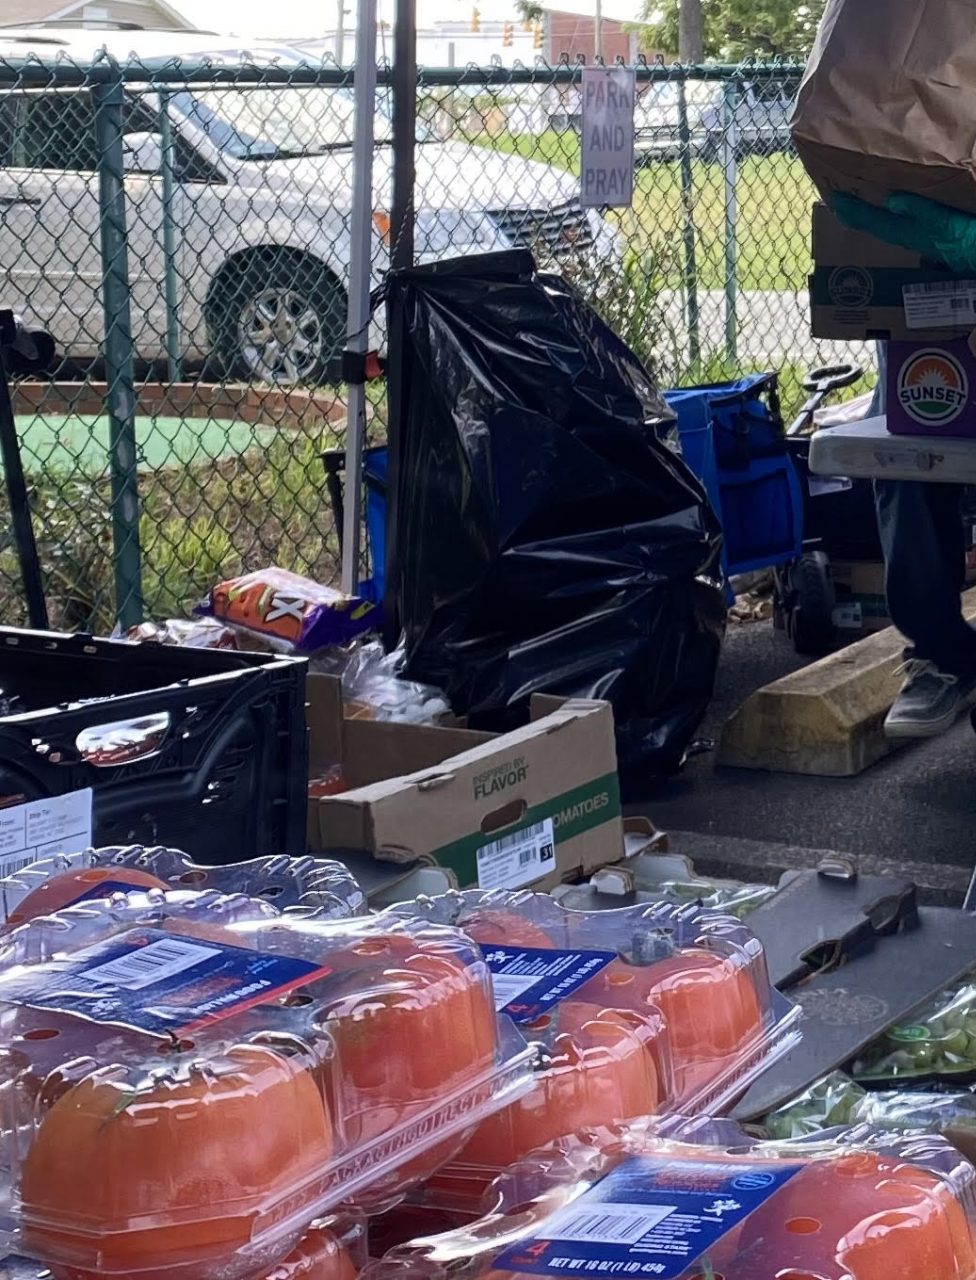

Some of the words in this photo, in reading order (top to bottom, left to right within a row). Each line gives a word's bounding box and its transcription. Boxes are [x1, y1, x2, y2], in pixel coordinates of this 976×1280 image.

[585, 81, 630, 108] PARK
[590, 124, 625, 152] AND
[585, 167, 629, 195] PRAY
[901, 387, 966, 405] SUNSET
[474, 768, 528, 800] FLAVOR
[554, 791, 609, 828] OMATOES
[548, 1257, 571, 1269] NET
[568, 1259, 587, 1270] WT
[585, 1260, 599, 1271] 16
